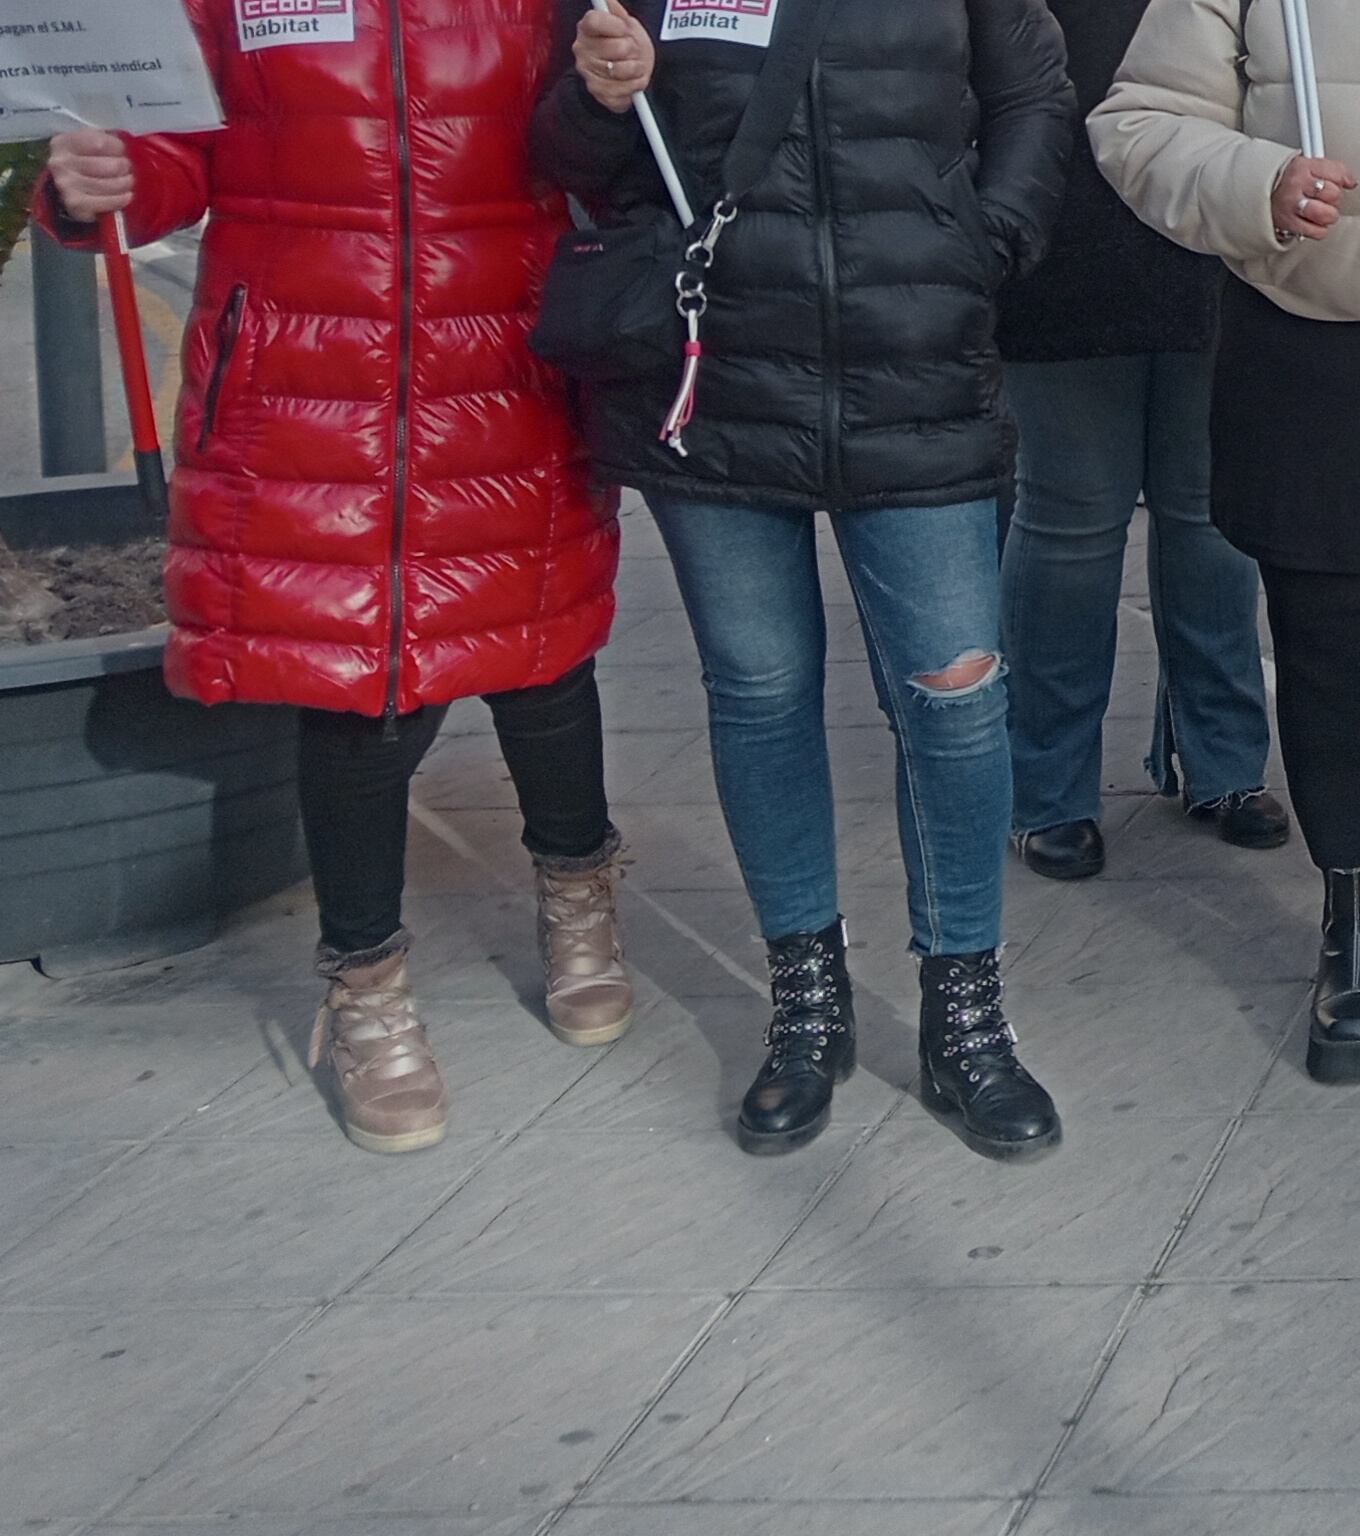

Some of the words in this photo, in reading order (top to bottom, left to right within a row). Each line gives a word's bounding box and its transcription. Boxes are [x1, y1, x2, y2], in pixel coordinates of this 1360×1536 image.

[38, 21, 48, 32] el
[242, 18, 320, 40] hábitat
[667, 12, 740, 30] hábitat
[33, 64, 45, 75] la
[48, 61, 107, 77] represión
[111, 58, 162, 71] sindical
